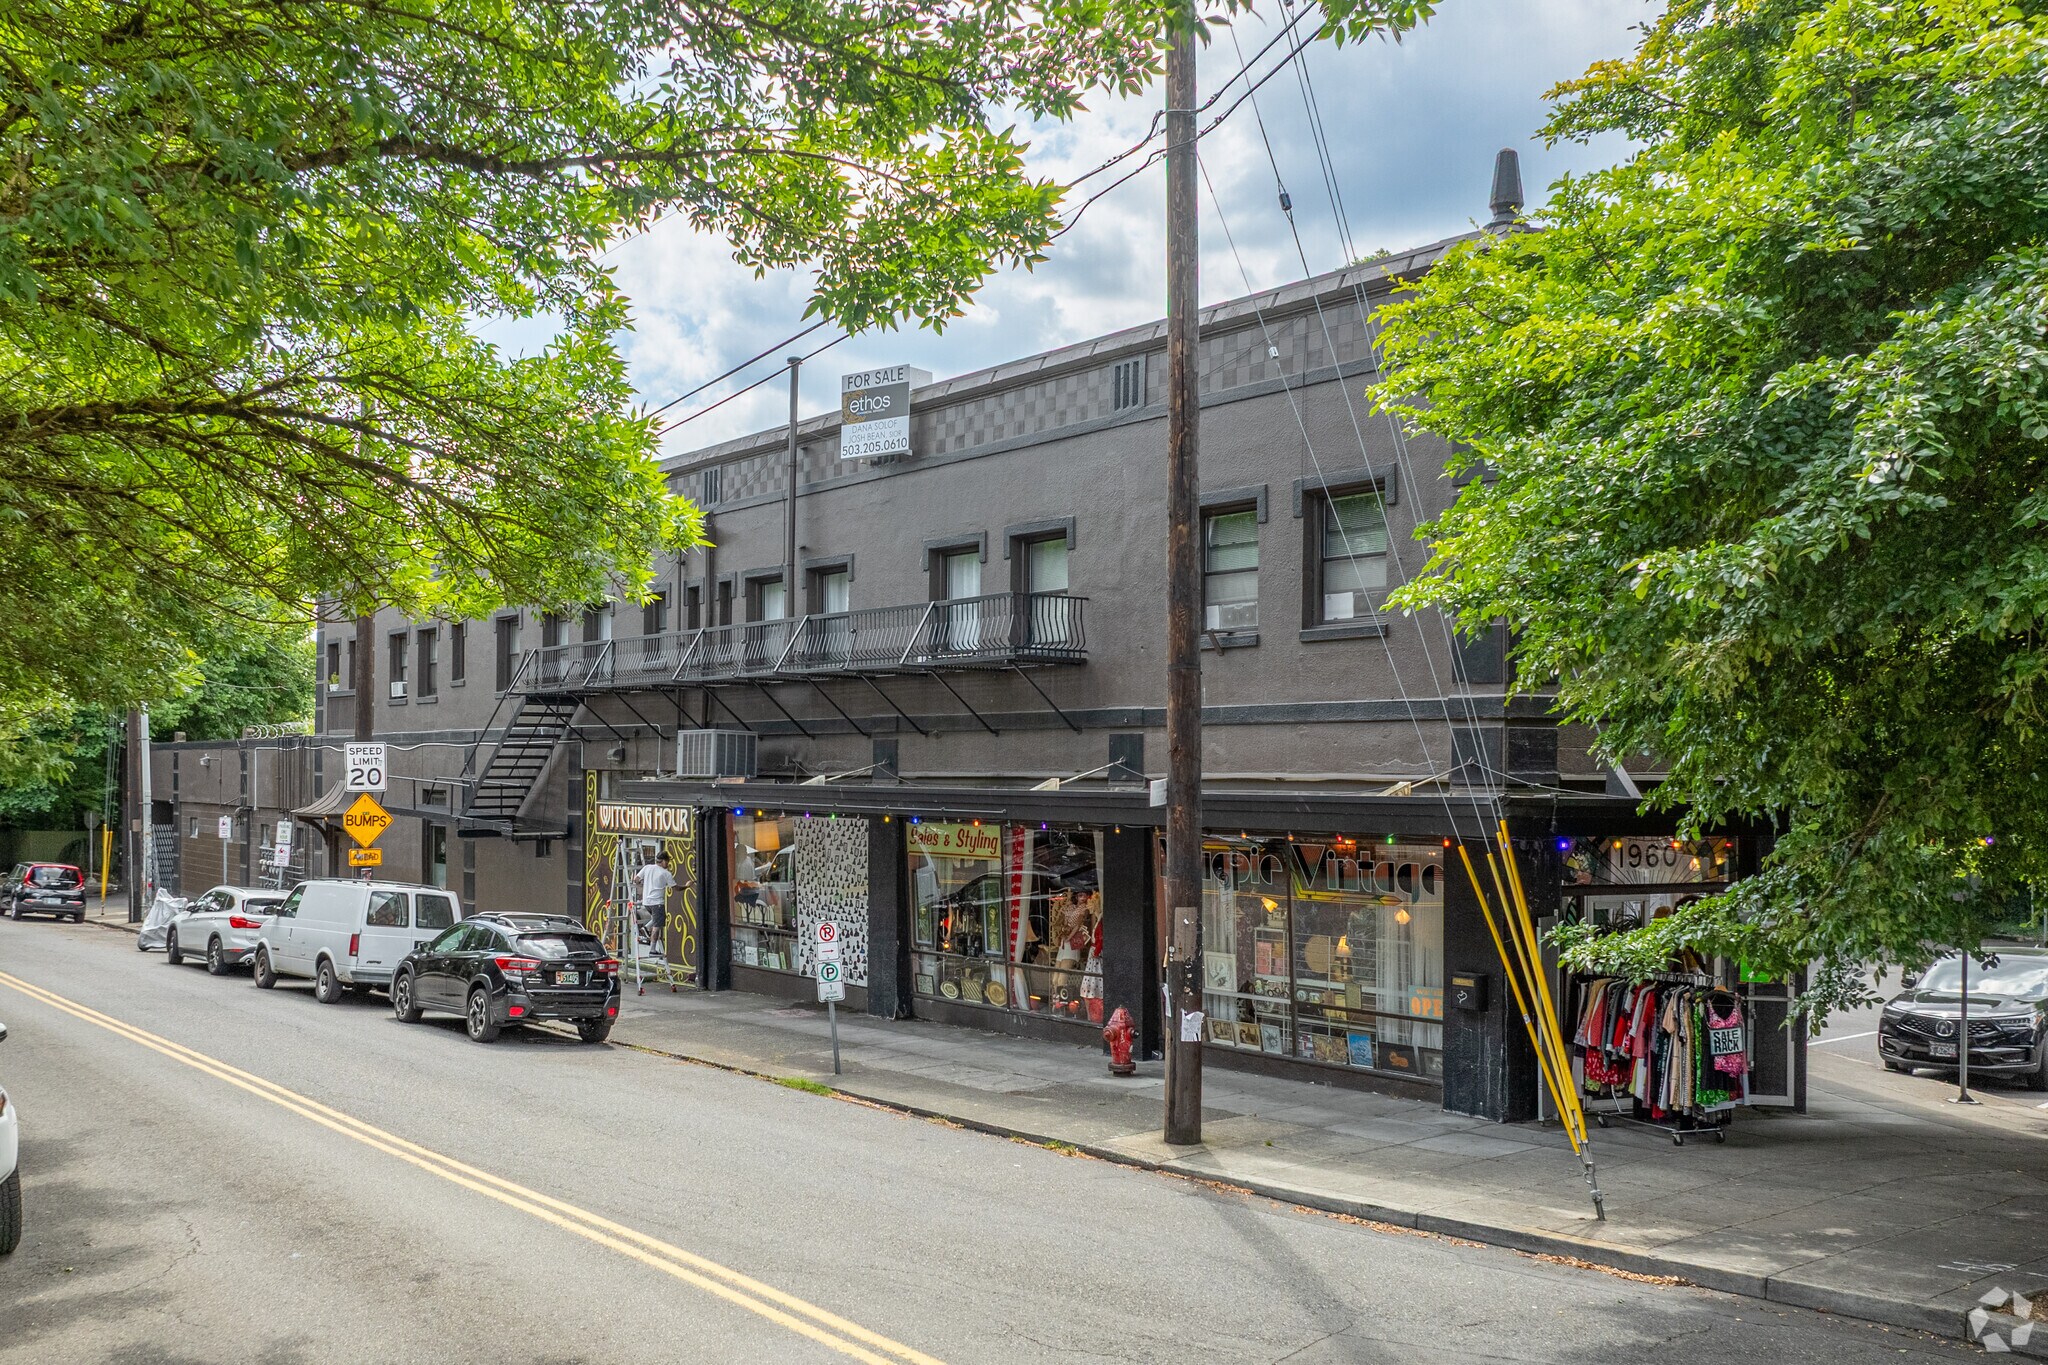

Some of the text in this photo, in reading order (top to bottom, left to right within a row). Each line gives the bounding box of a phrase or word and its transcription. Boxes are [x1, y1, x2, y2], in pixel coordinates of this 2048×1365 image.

[847, 367, 904, 390] FOR SALE
[849, 395, 891, 414] ethos
[851, 424, 873, 434] DANA
[842, 437, 908, 457] 503.205.0610
[848, 434, 866, 444] JOSH
[349, 747, 383, 756] SPEED
[352, 757, 379, 766] LIMIT
[350, 767, 382, 786] 20
[345, 814, 387, 828] BUMPS
[599, 804, 689, 833] WITCHING HOUR
[909, 825, 999, 855] Sales & Styling
[1619, 843, 1677, 869] 1960
[1713, 1030, 1739, 1041] SALE
[1714, 1040, 1739, 1052] RACK
